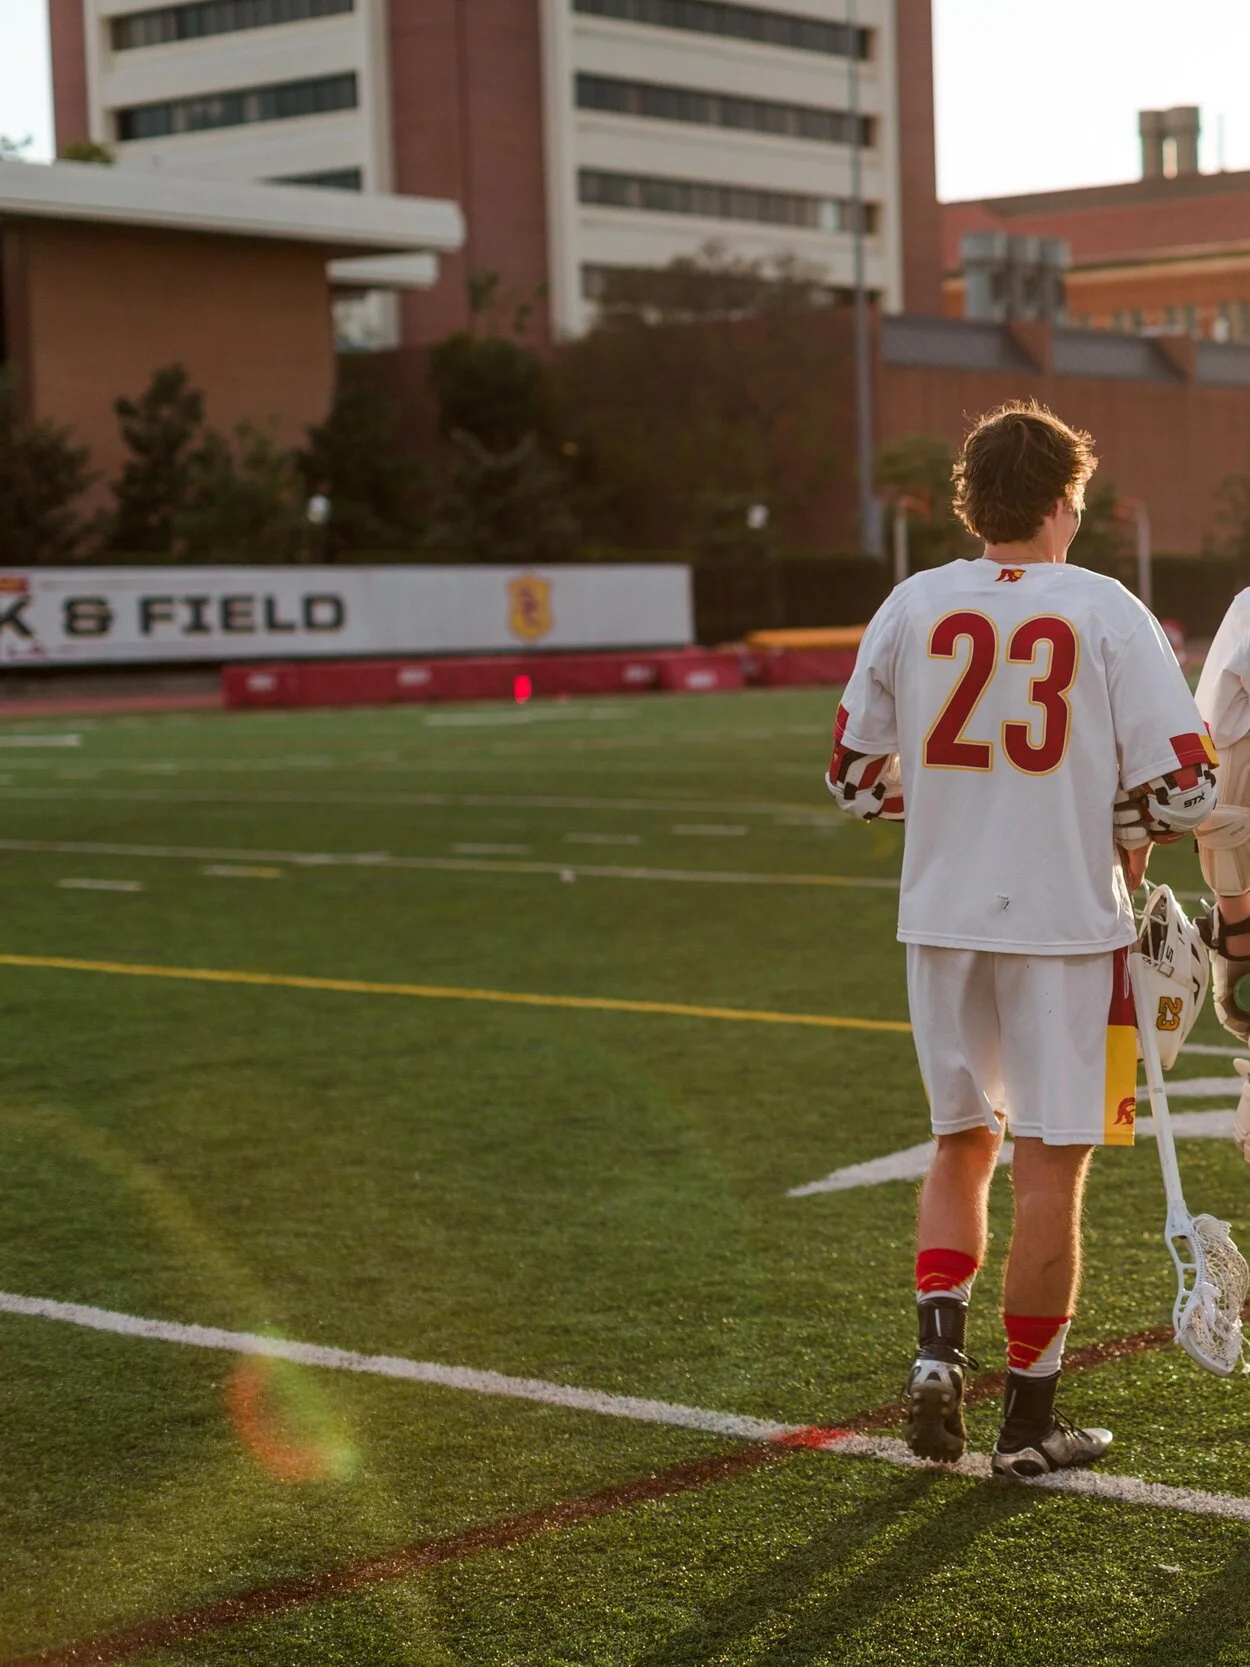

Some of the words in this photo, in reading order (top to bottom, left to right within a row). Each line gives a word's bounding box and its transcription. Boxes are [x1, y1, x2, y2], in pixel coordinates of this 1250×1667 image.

[63, 595, 113, 637] &
[139, 593, 346, 636] FIELD
[922, 609, 1080, 776] 23
[1183, 792, 1205, 808] STX
[1156, 996, 1183, 1031] 23
